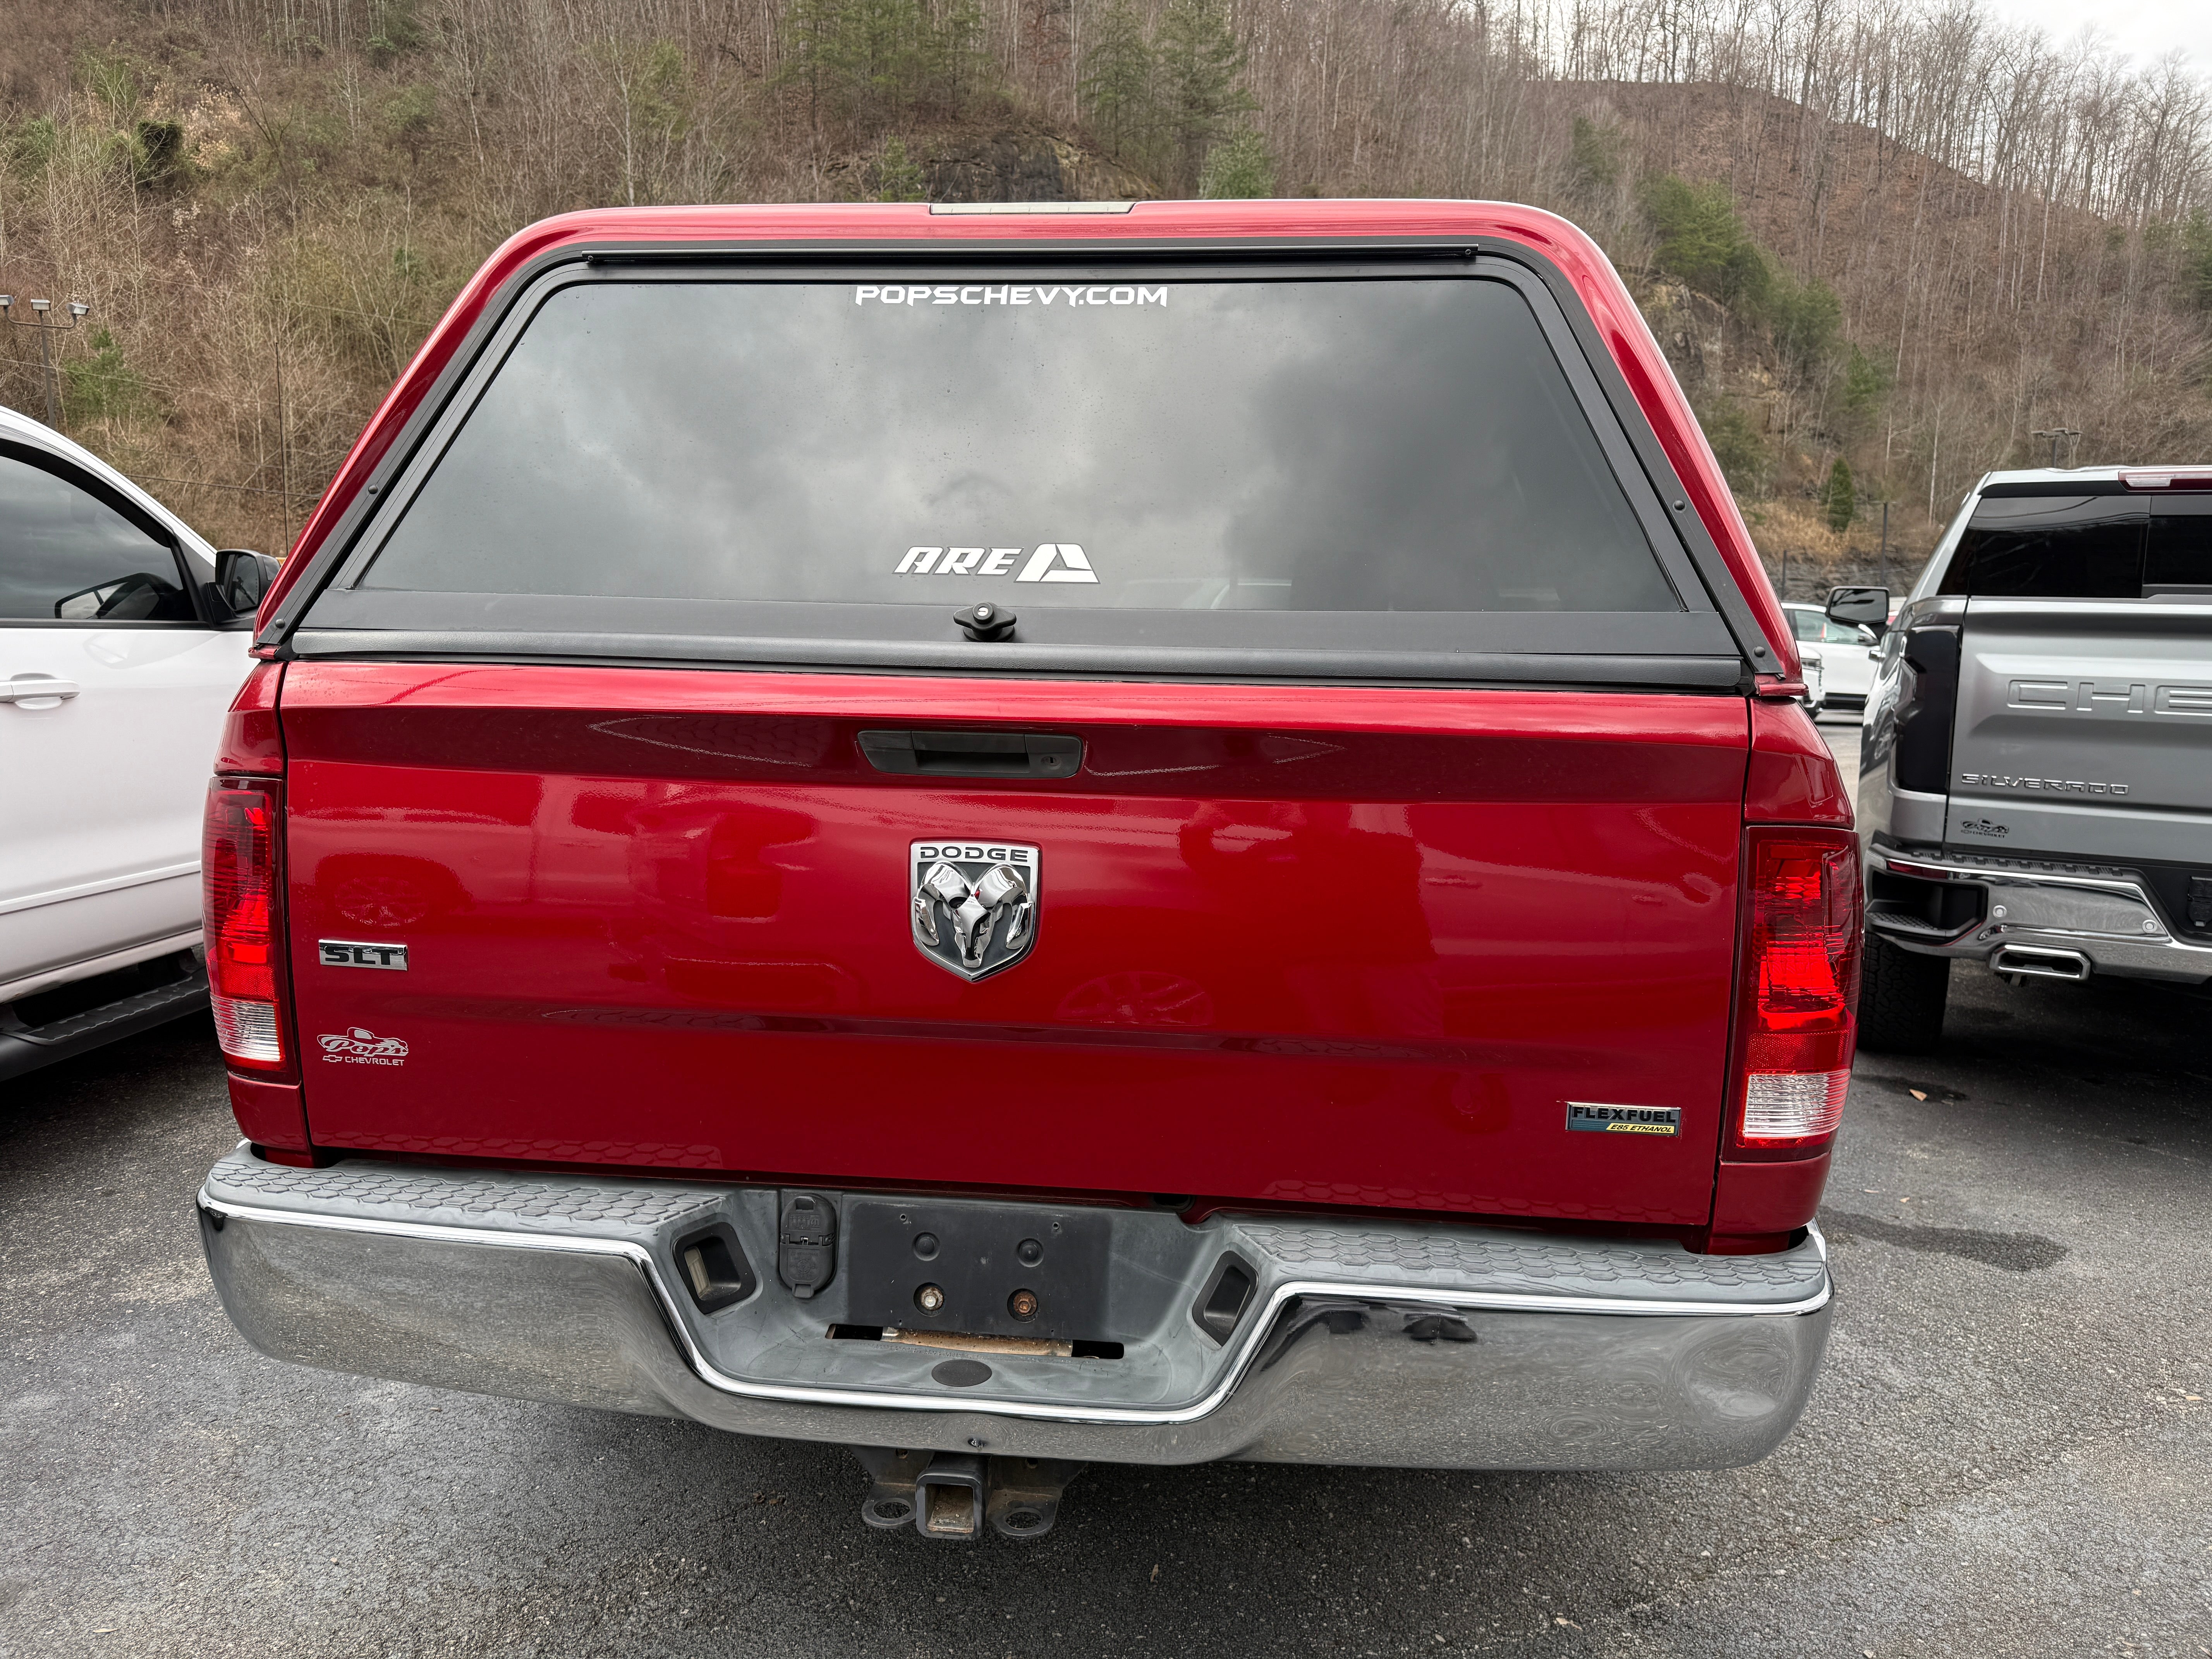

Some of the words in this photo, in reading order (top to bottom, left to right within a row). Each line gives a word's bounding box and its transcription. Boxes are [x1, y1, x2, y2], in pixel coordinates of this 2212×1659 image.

[855, 285, 1168, 307] POPSCHEVY.COM
[892, 546, 1024, 575] ARE
[1961, 773, 2128, 795] SILVERADO
[920, 846, 1028, 862] DODGE
[324, 945, 402, 965] SLT
[345, 1056, 404, 1066] CHEVROLET
[1572, 1106, 1676, 1123] FLEXFUEL
